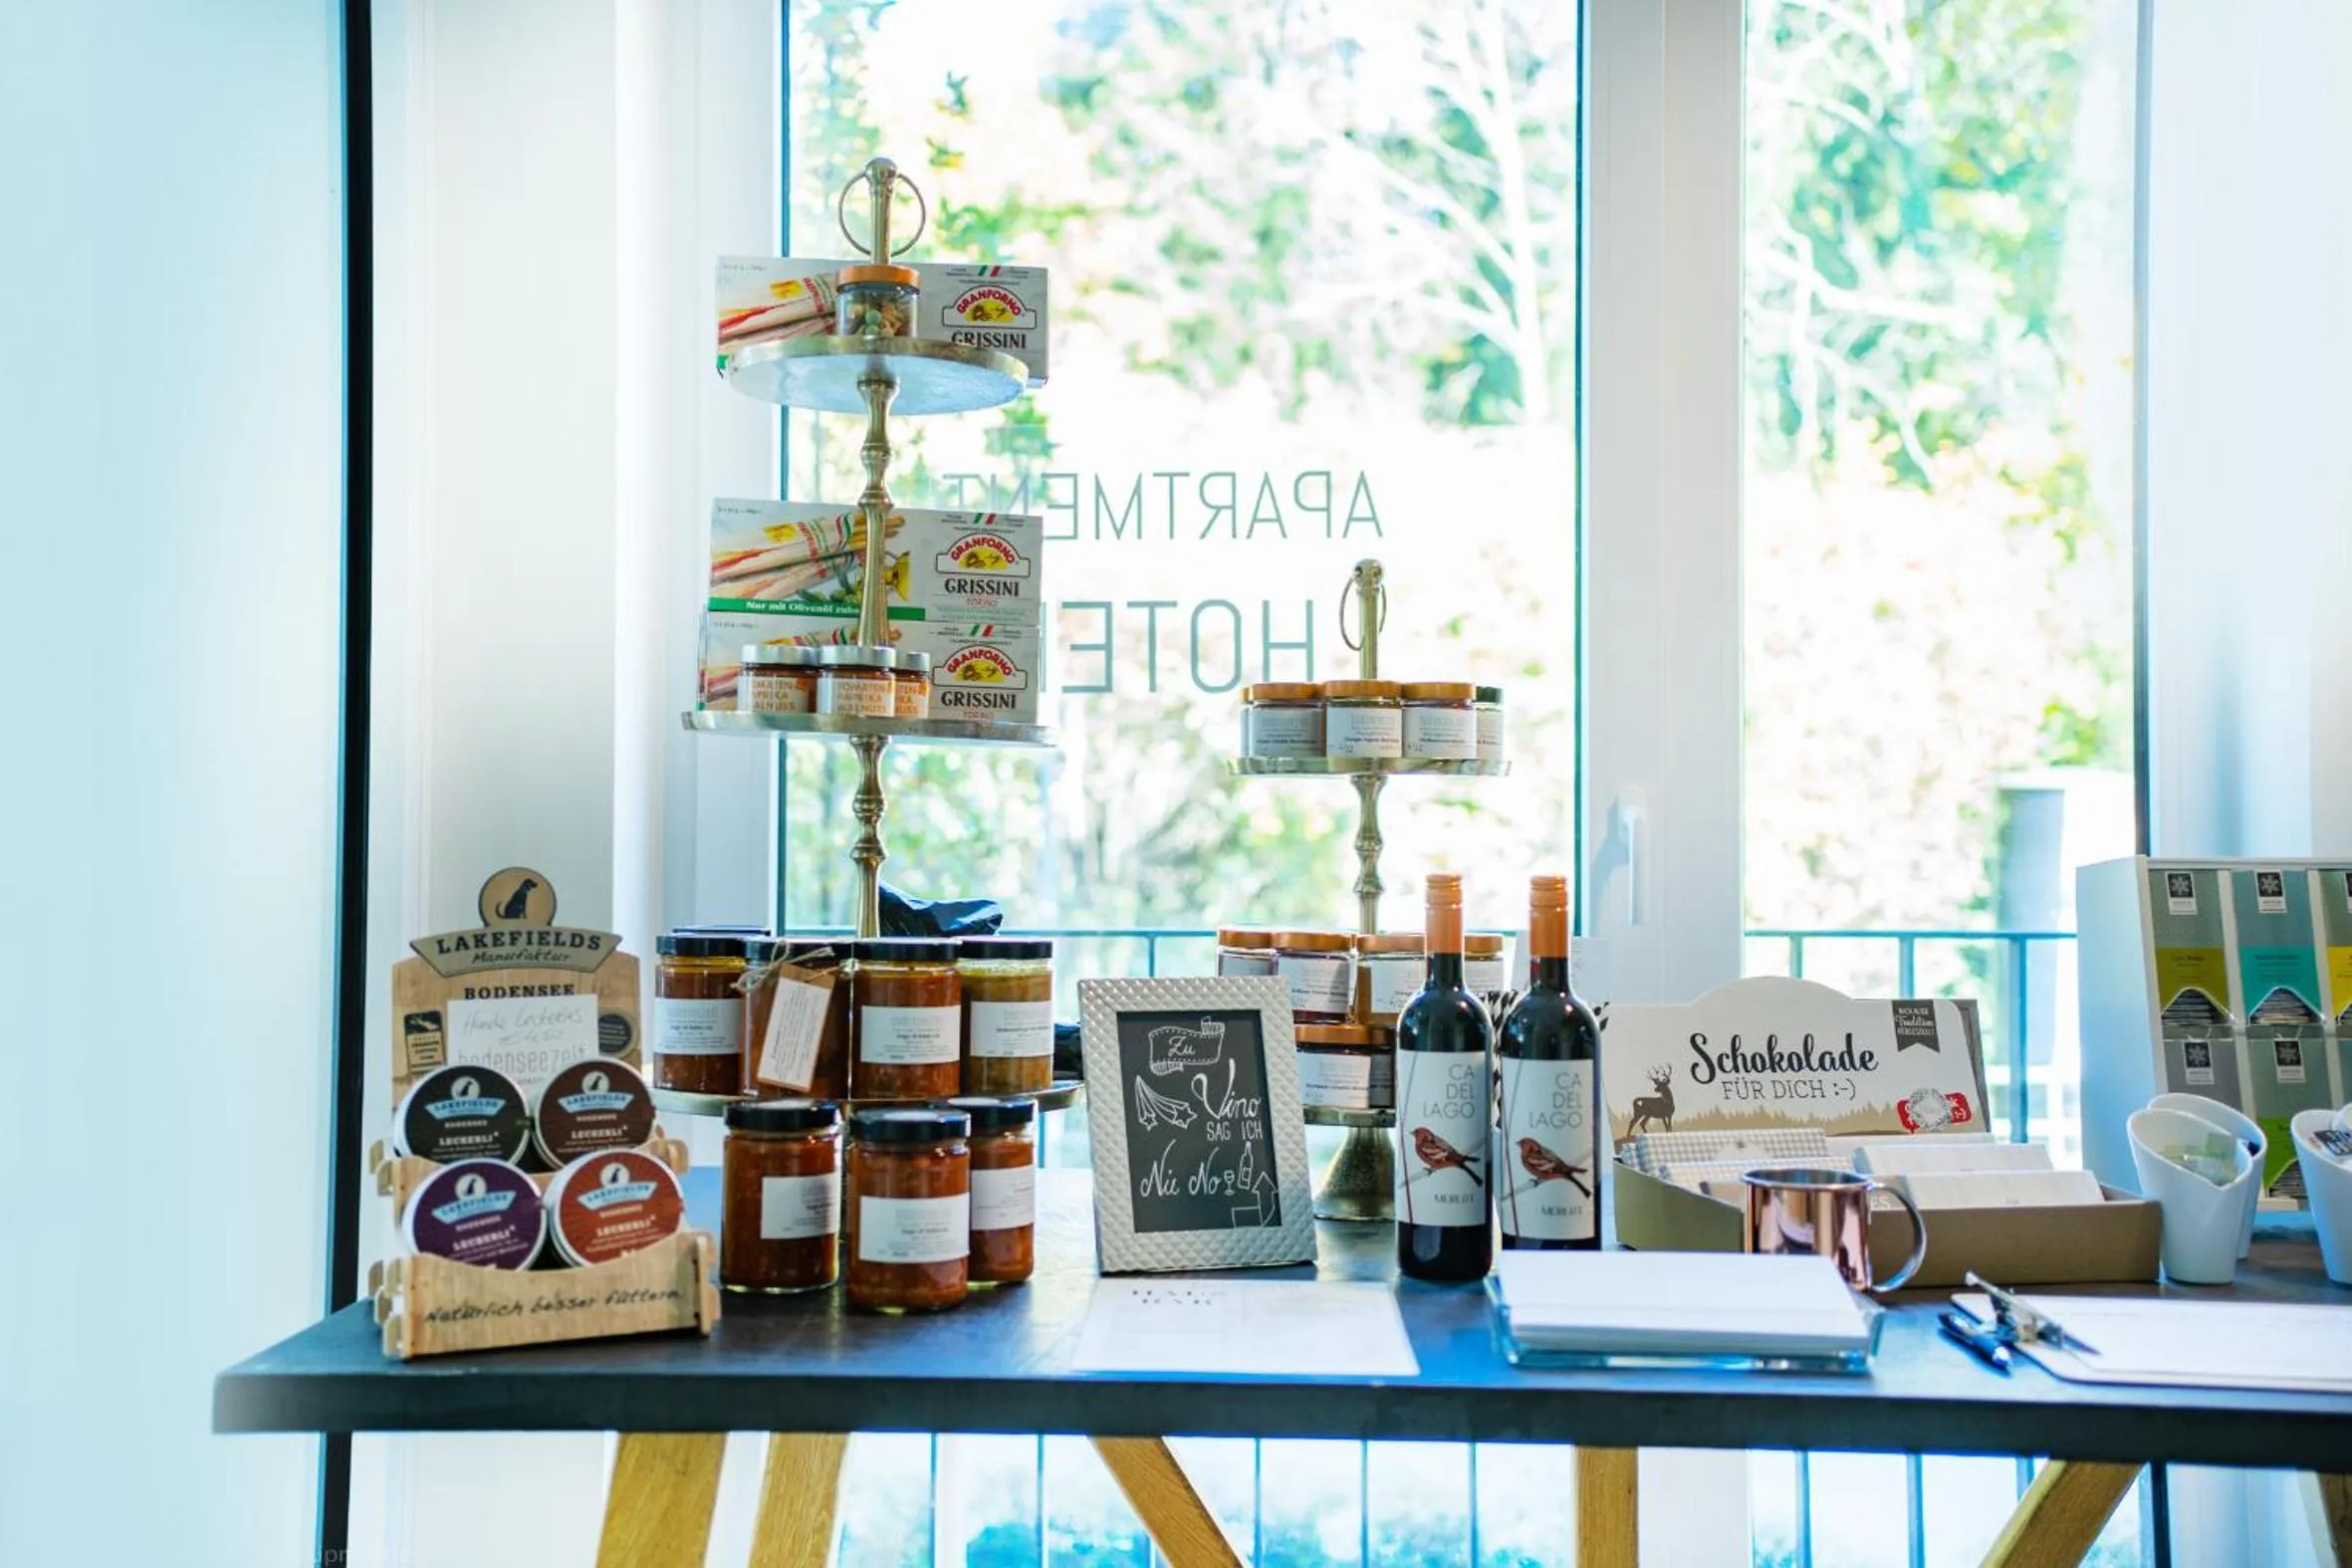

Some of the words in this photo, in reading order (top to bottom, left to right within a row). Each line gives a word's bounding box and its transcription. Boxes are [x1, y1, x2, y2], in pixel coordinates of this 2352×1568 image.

[956, 289, 1022, 317] GRANFORNO
[951, 331, 1027, 349] GRISSINI
[951, 537, 1016, 564] GRANFORNO
[944, 577, 1020, 597] GRISSINI
[745, 600, 766, 610] Nur
[768, 601, 787, 611] mit
[947, 648, 1012, 677] GRANFORNO
[941, 690, 1017, 710] GRISSINI
[435, 931, 602, 955] LAKEFIELDS
[472, 949, 571, 965] Manufaktur
[464, 984, 576, 1001] BODENSEE
[1167, 1035, 1196, 1056] Zu
[1689, 1032, 1880, 1085] Schokolade
[1448, 1063, 1475, 1081] CA
[1554, 1071, 1583, 1090] CA
[1191, 1057, 1263, 1120] Vino
[1446, 1083, 1475, 1100] DEL
[1721, 1076, 1766, 1101] FÜR
[1770, 1078, 1827, 1100] DICH
[1423, 1101, 1476, 1119] LAGO
[1552, 1091, 1583, 1109] DEL
[1529, 1110, 1583, 1129] LAGO
[1206, 1121, 1232, 1141] SAG
[1241, 1120, 1264, 1141] ICH
[424, 1298, 524, 1324] Natürlich
[530, 1292, 596, 1314] besser
[604, 1288, 683, 1305] füttern
